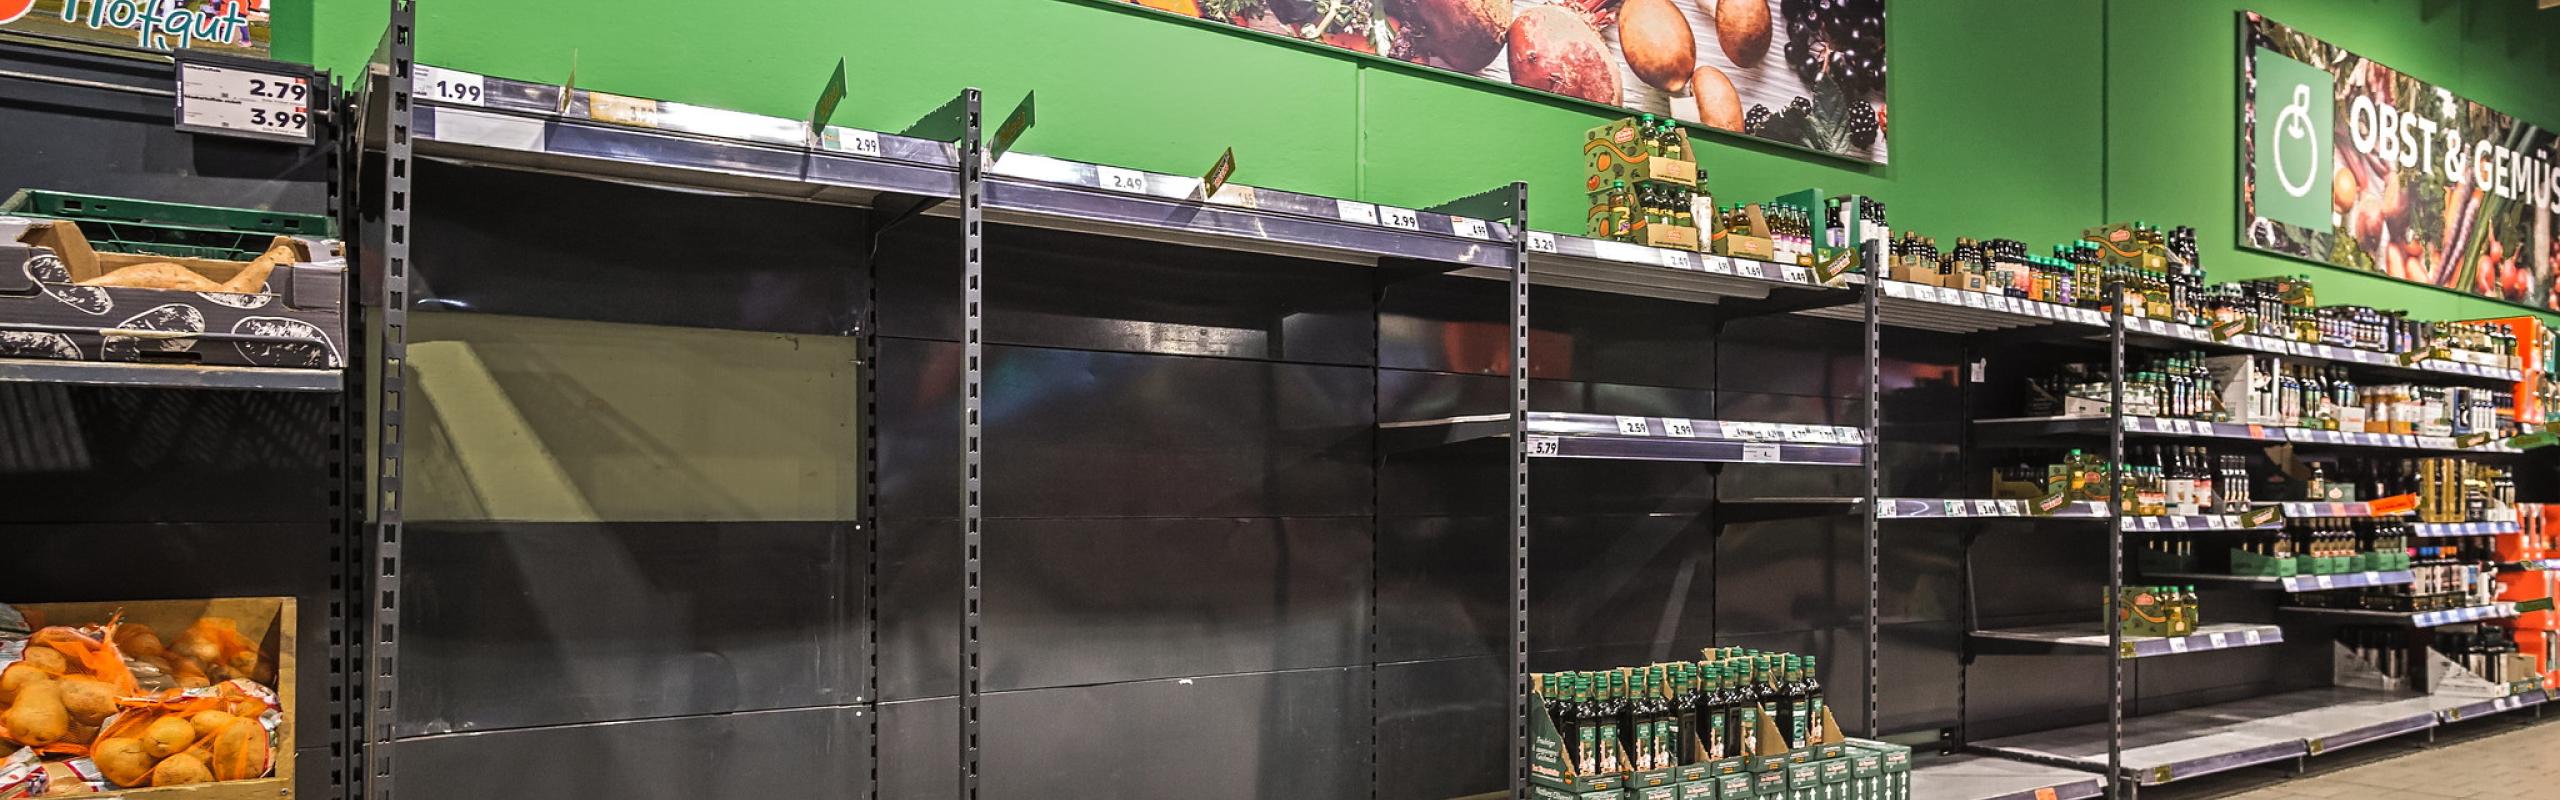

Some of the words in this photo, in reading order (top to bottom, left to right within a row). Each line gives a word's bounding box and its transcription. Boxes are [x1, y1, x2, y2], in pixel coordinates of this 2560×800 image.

[250, 79, 306, 101] 2.79
[436, 80, 481, 101] 1.99
[250, 108, 307, 129] 3.99
[856, 137, 877, 152] 2.99
[2350, 95, 2437, 176] OBST
[2444, 129, 2467, 183] &
[1113, 175, 1142, 190] 2.49
[1392, 214, 1416, 227] 2.99
[1627, 422, 1646, 433] 2.59
[1535, 442, 1557, 454] 5.79
